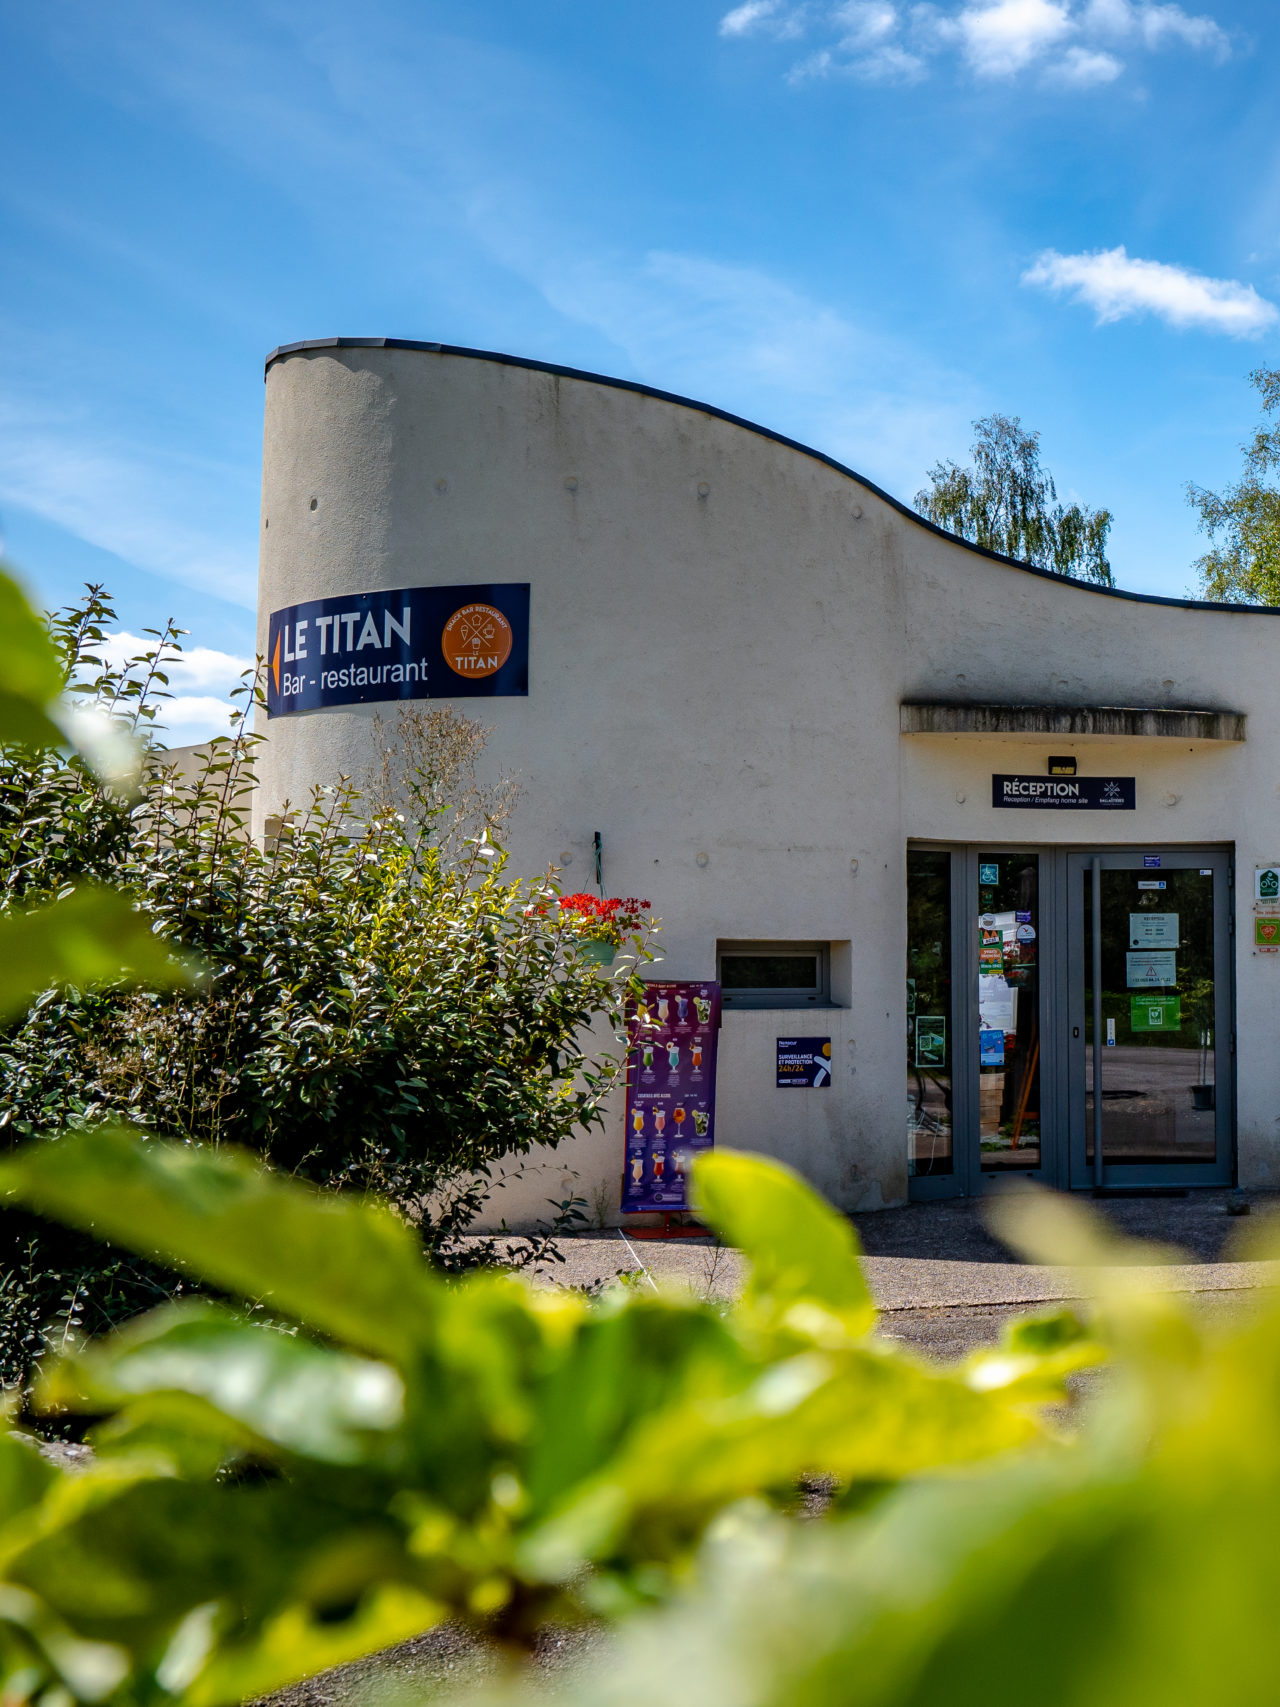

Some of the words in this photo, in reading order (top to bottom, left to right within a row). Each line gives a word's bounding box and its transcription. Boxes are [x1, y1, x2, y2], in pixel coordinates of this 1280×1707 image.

[446, 612, 463, 632] SNACK
[461, 606, 474, 615] BAR
[475, 605, 508, 629] RESTAURANT
[284, 619, 309, 663] LE
[315, 607, 412, 656] TITAN
[455, 655, 498, 670] TITAN
[283, 672, 306, 697] Bar
[320, 657, 428, 690] restaurant
[1003, 778, 1079, 796] RÉCEPTION
[1035, 797, 1060, 805] Empfang
